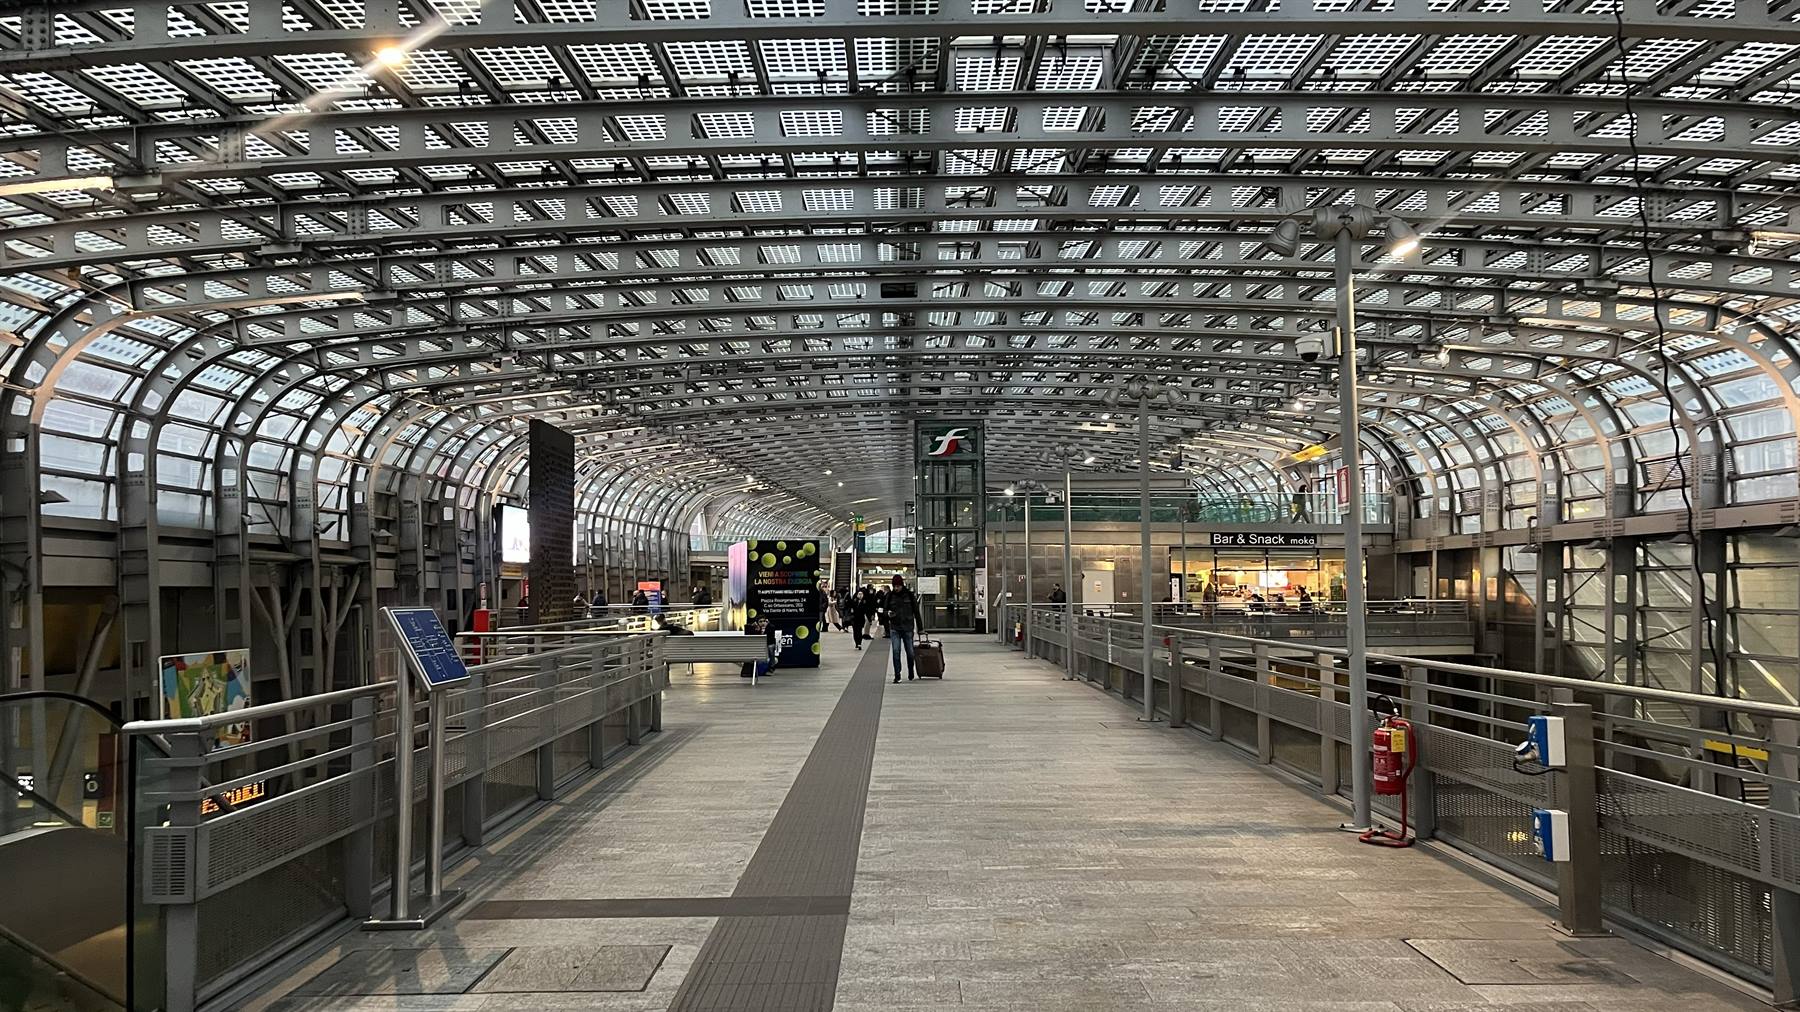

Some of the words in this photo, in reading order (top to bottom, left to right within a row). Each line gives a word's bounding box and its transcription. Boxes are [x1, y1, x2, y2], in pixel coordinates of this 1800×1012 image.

[1213, 533, 1234, 544] Bar
[1236, 533, 1246, 544] &
[1248, 533, 1285, 544] Snack
